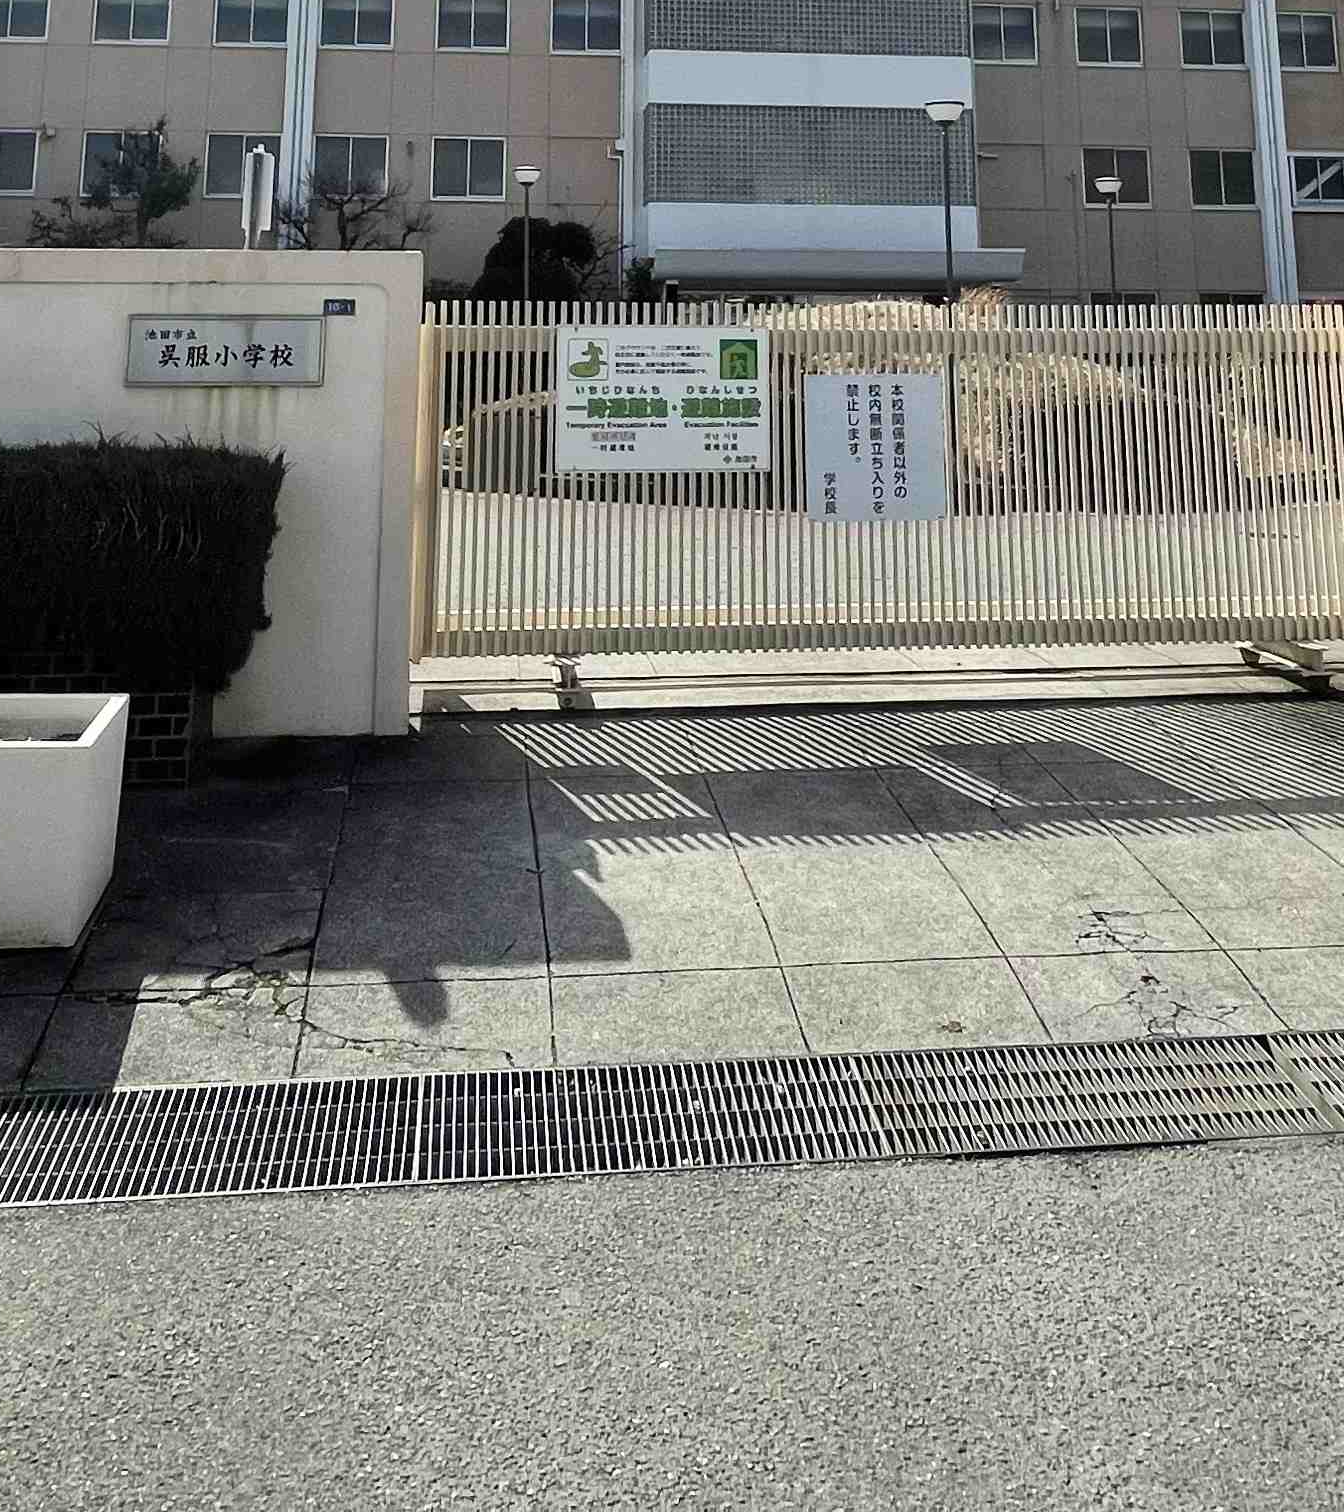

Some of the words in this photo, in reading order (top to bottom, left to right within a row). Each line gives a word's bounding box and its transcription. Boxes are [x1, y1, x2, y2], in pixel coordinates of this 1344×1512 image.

[144, 328, 198, 341] 池田市立
[158, 344, 295, 369] 呉服小学校
[846, 384, 862, 464] 禁止します。
[868, 384, 885, 514] 校内無断立ち入りを
[891, 384, 908, 499] 本校関係者以外の
[824, 472, 838, 514] 学校長
